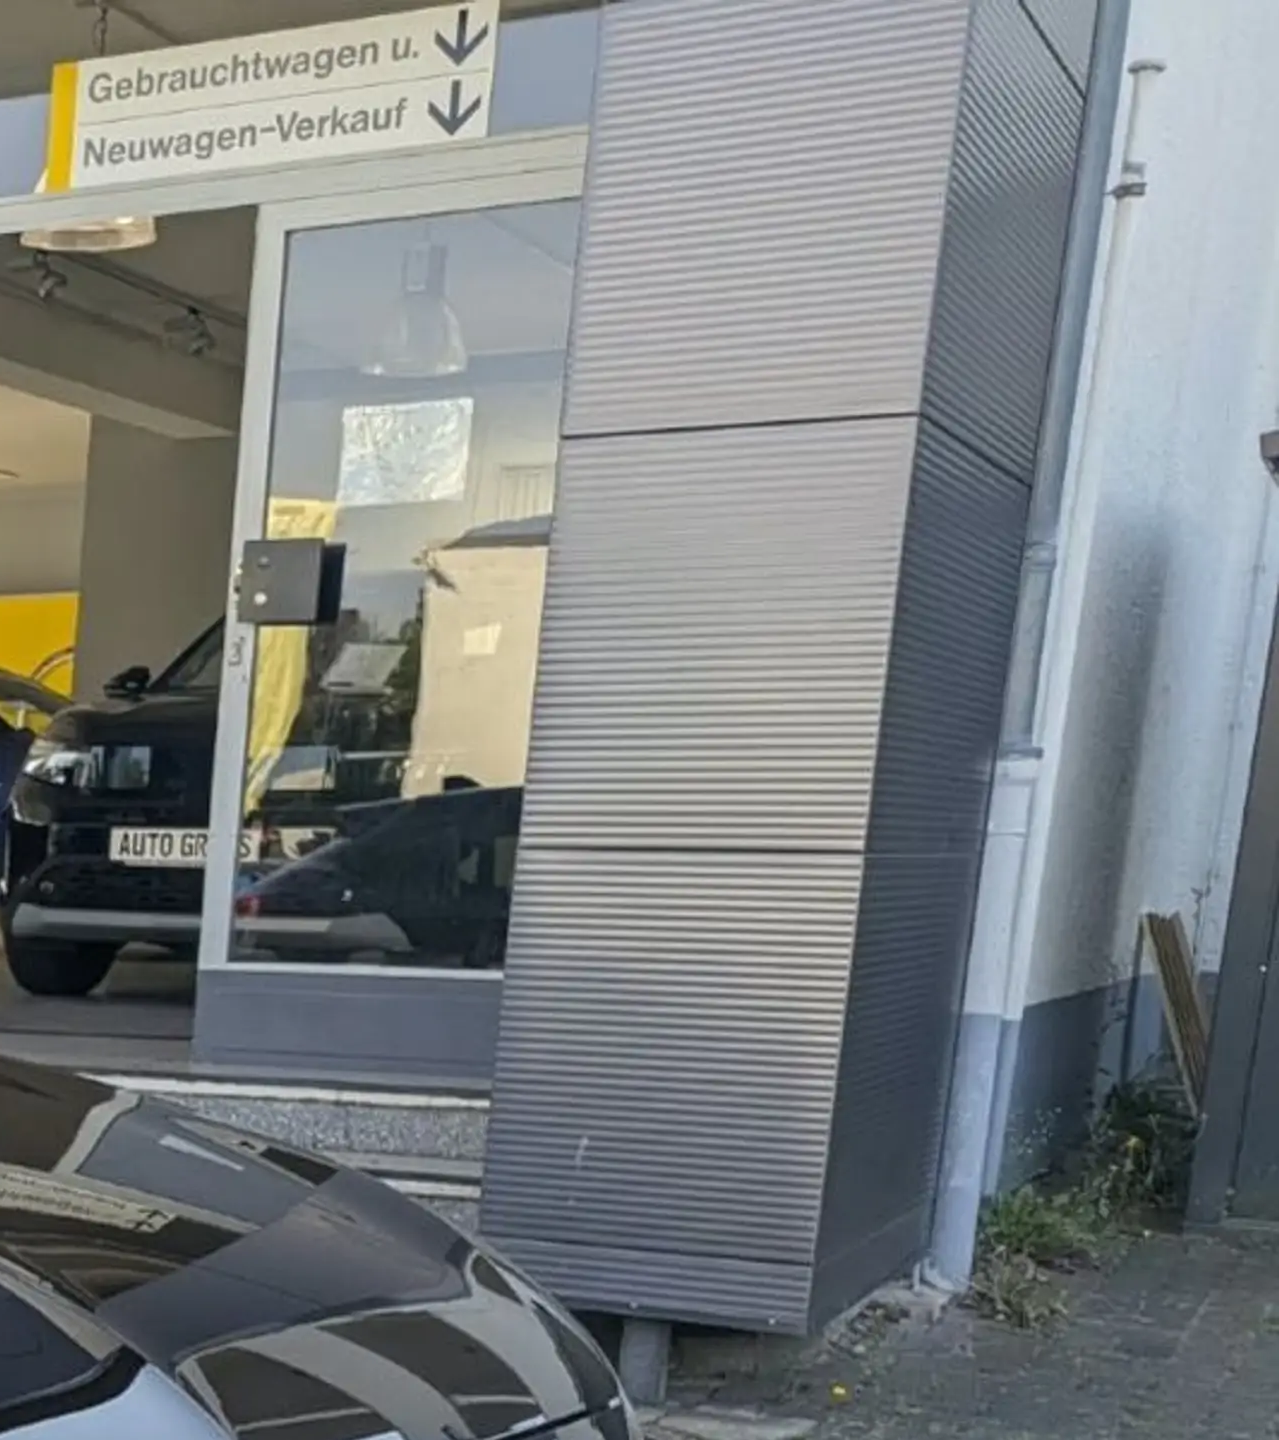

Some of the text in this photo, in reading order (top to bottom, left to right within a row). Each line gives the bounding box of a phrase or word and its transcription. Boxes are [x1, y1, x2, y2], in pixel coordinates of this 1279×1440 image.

[87, 36, 420, 103] Gebrauchtwagen u.
[83, 97, 408, 168] Neuwagen-Verkauf
[119, 831, 252, 858] AUTO GRS
